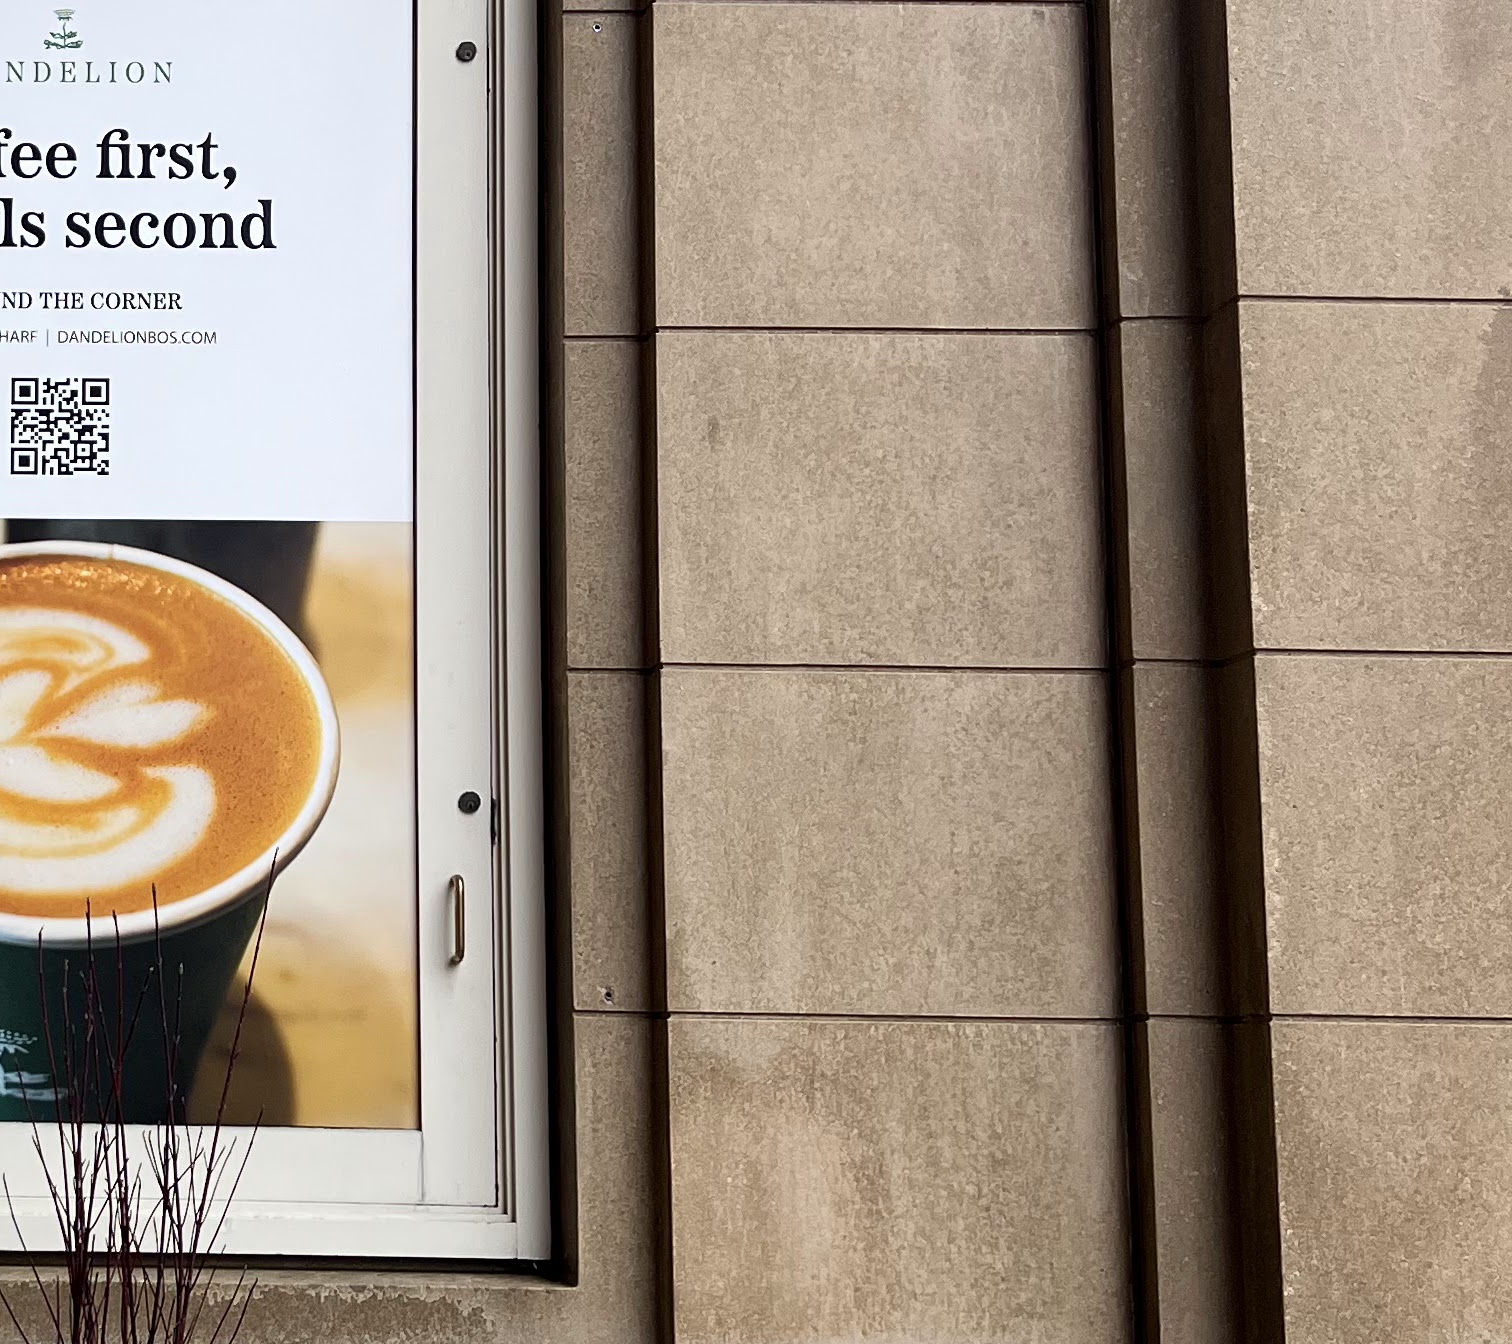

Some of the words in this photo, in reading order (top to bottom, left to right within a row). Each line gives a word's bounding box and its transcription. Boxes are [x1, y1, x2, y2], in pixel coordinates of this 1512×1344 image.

[95, 128, 238, 190] first,
[64, 198, 278, 250] second
[38, 291, 85, 311] THE
[90, 291, 184, 311] CORNER
[57, 330, 218, 345] DANDELIONBOS.COM
